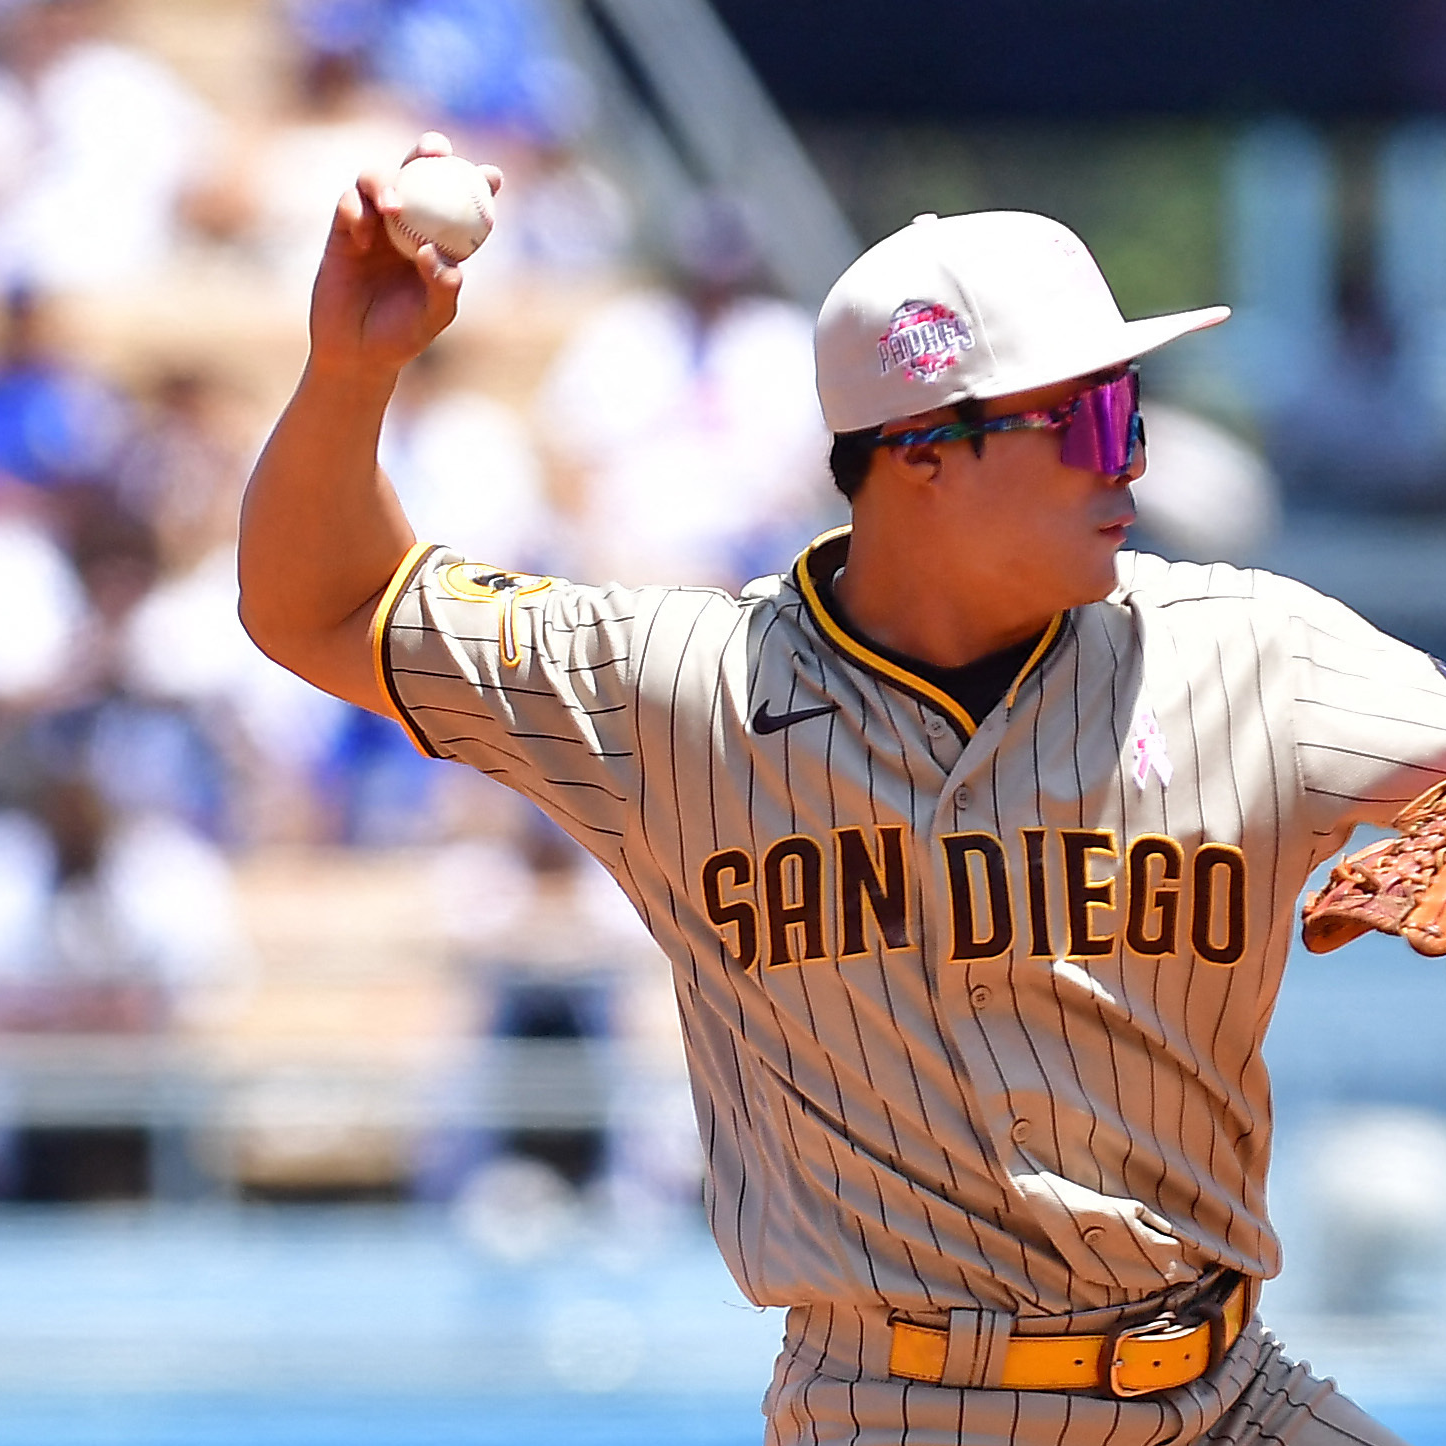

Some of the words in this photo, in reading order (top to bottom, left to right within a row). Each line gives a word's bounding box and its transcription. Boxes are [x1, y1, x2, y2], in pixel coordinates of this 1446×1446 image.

[877, 318, 976, 376] PADRES
[702, 822, 917, 972] SAN
[940, 827, 1248, 967] DIEGO
